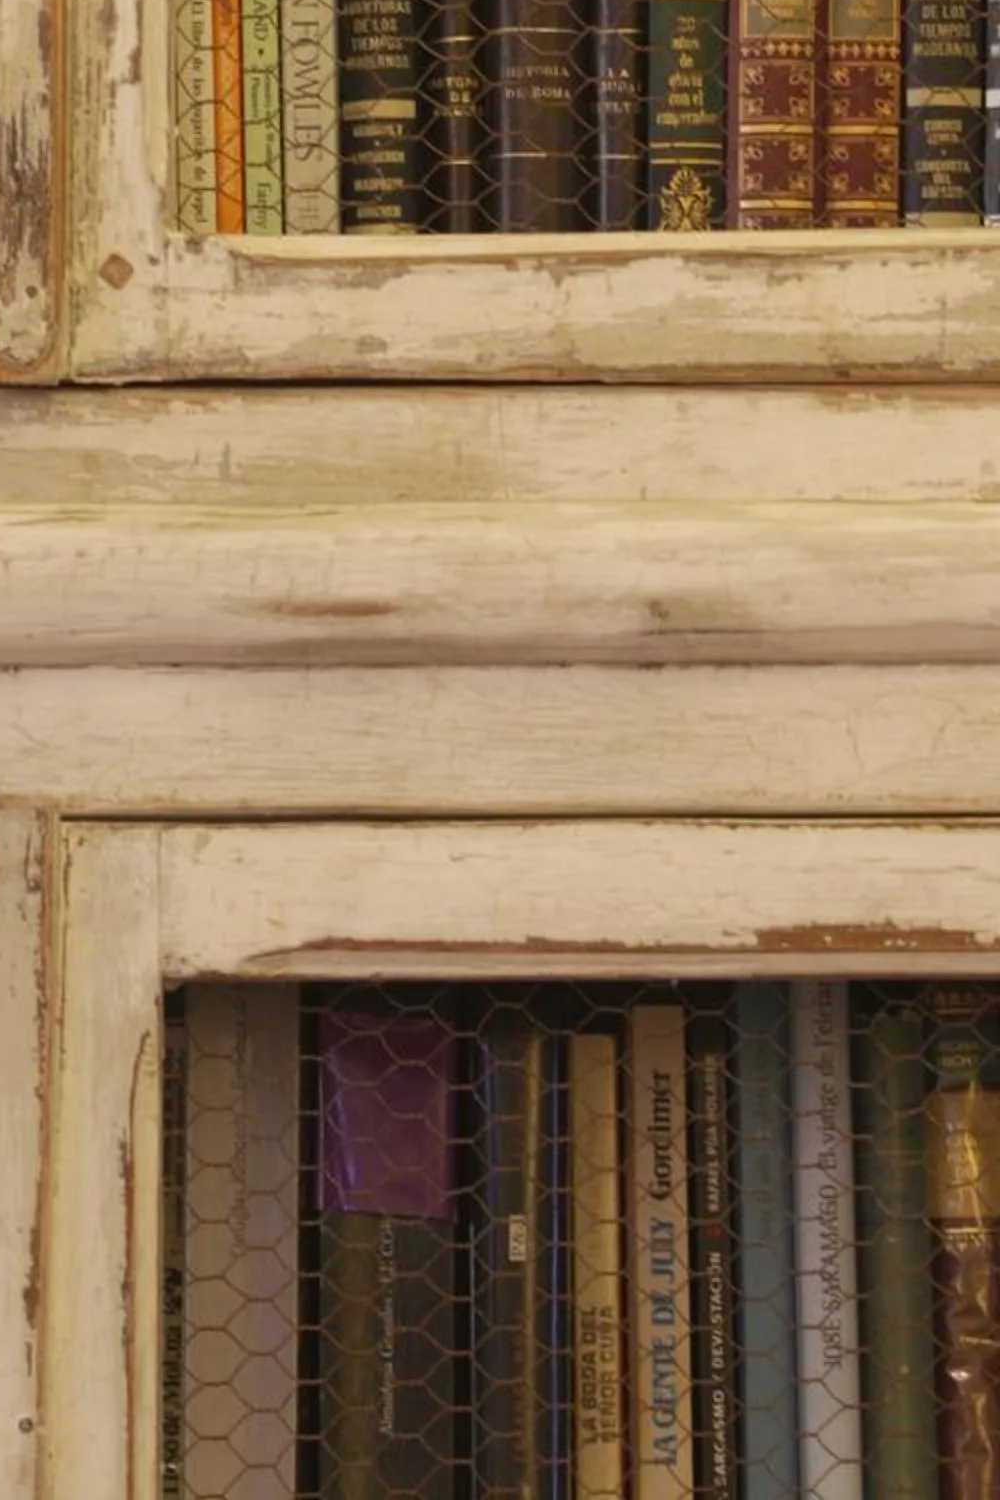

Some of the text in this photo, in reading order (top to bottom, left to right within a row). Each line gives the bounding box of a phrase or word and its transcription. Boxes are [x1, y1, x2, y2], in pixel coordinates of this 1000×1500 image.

[922, 4, 937, 19] DE
[291, 19, 320, 163] FOWLES
[531, 85, 571, 99] ROMA
[646, 1067, 678, 1466] LA GENTE DE JULY Gordimer
[817, 1183, 841, 1311] SARAMAGO
[580, 1306, 596, 1346] DEL
[581, 1352, 597, 1410] BODA
[712, 1388, 727, 1487] SARCASMO
